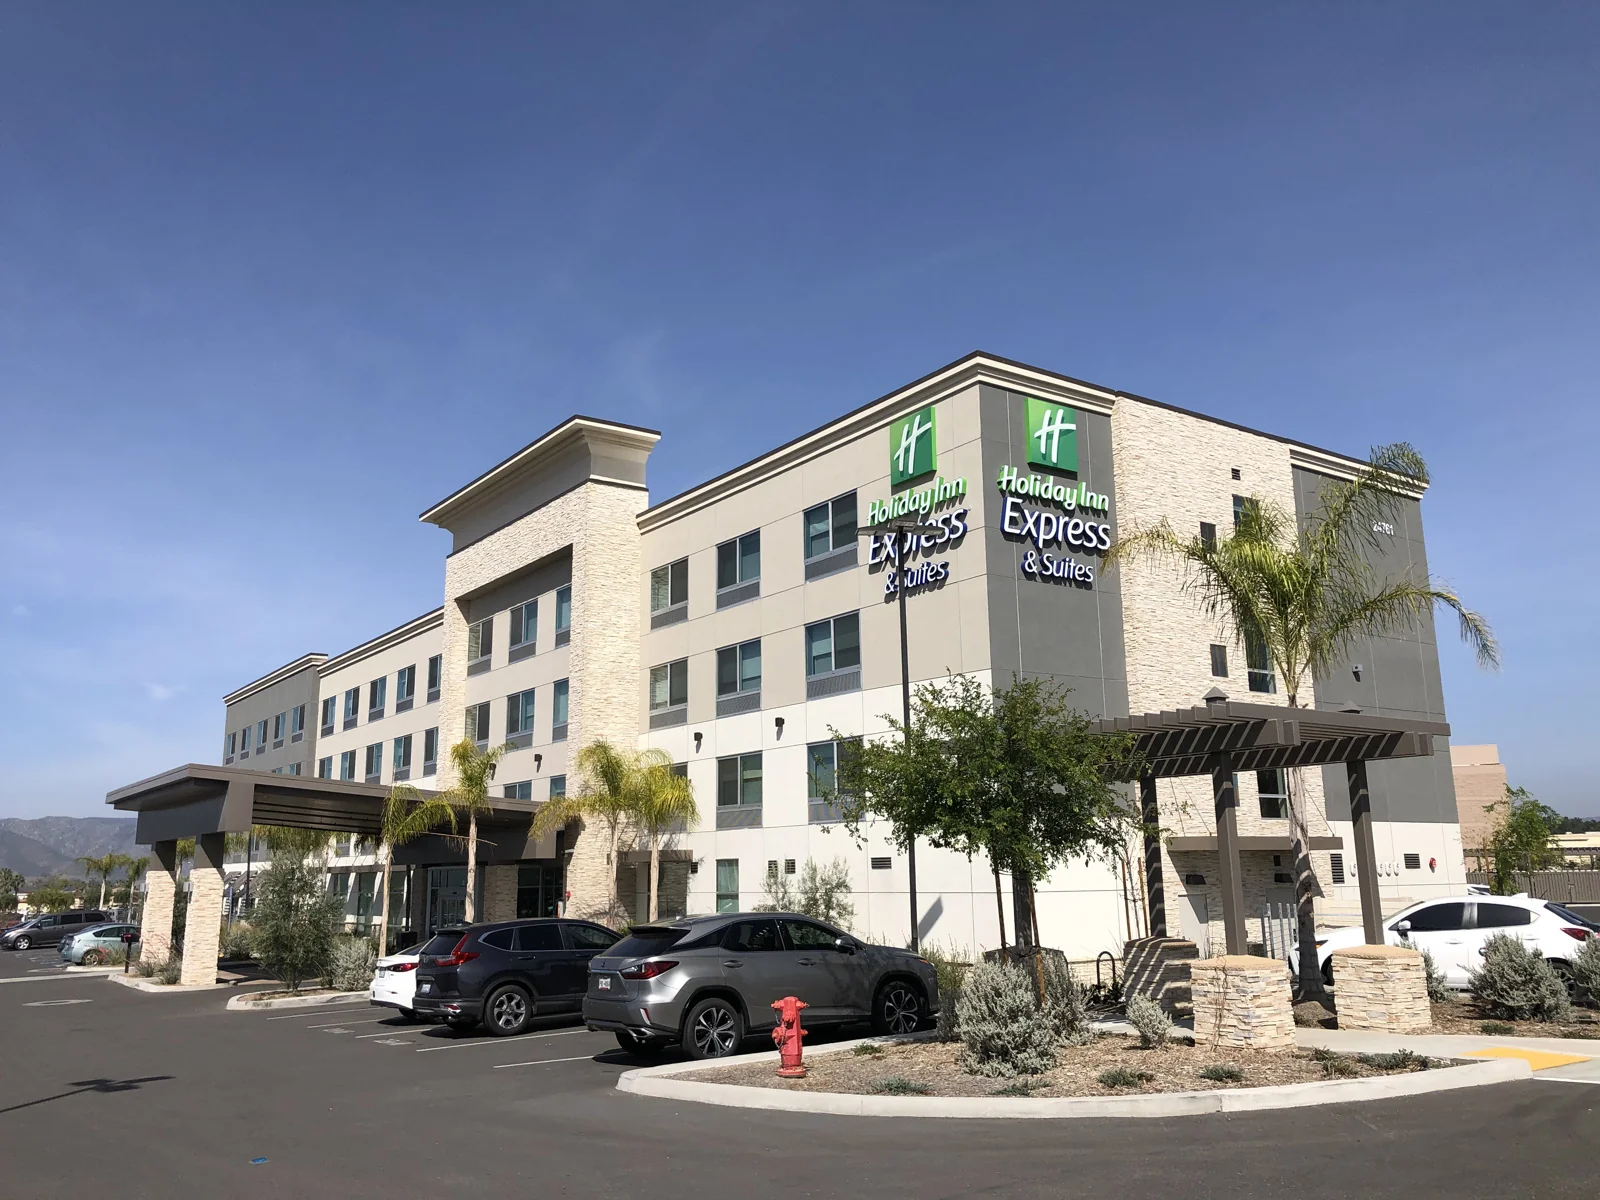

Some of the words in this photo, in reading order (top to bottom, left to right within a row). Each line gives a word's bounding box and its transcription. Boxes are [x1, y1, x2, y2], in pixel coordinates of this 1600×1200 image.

[867, 488, 932, 526] Holiday
[934, 476, 966, 504] Inn
[998, 465, 1077, 510] Holiday
[1080, 481, 1109, 511] Inn
[1001, 497, 1111, 550] Express
[884, 572, 897, 593] &
[1023, 550, 1039, 574] &
[1041, 553, 1094, 582] Suites
